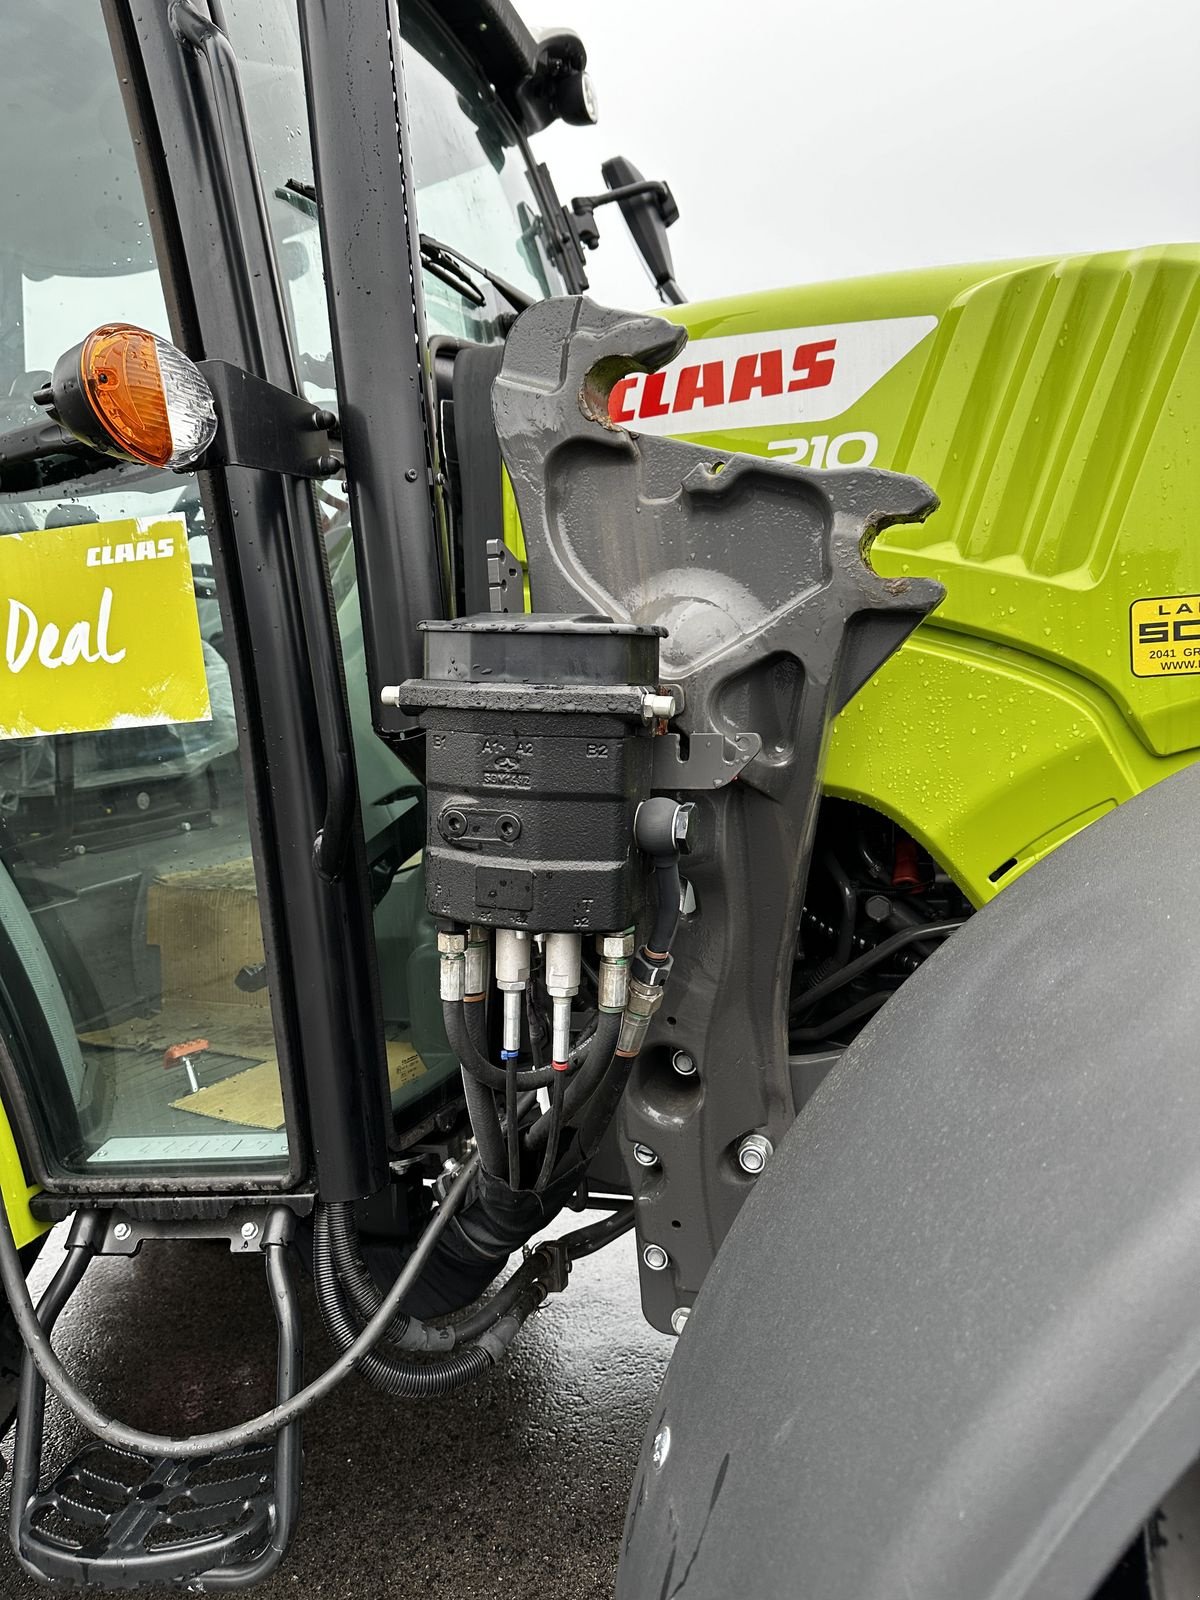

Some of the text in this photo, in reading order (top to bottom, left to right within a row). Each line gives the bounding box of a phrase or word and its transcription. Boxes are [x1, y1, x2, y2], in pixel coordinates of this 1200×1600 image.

[608, 339, 837, 424] CLAAS
[767, 431, 879, 470] 210
[86, 537, 175, 568] CLAAS
[1158, 603, 1200, 616] LA
[5, 586, 127, 674] Deal
[1149, 648, 1177, 659] 2041
[1160, 660, 1200, 671] WWW.
[515, 741, 534, 756] A2
[585, 743, 609, 759] B2
